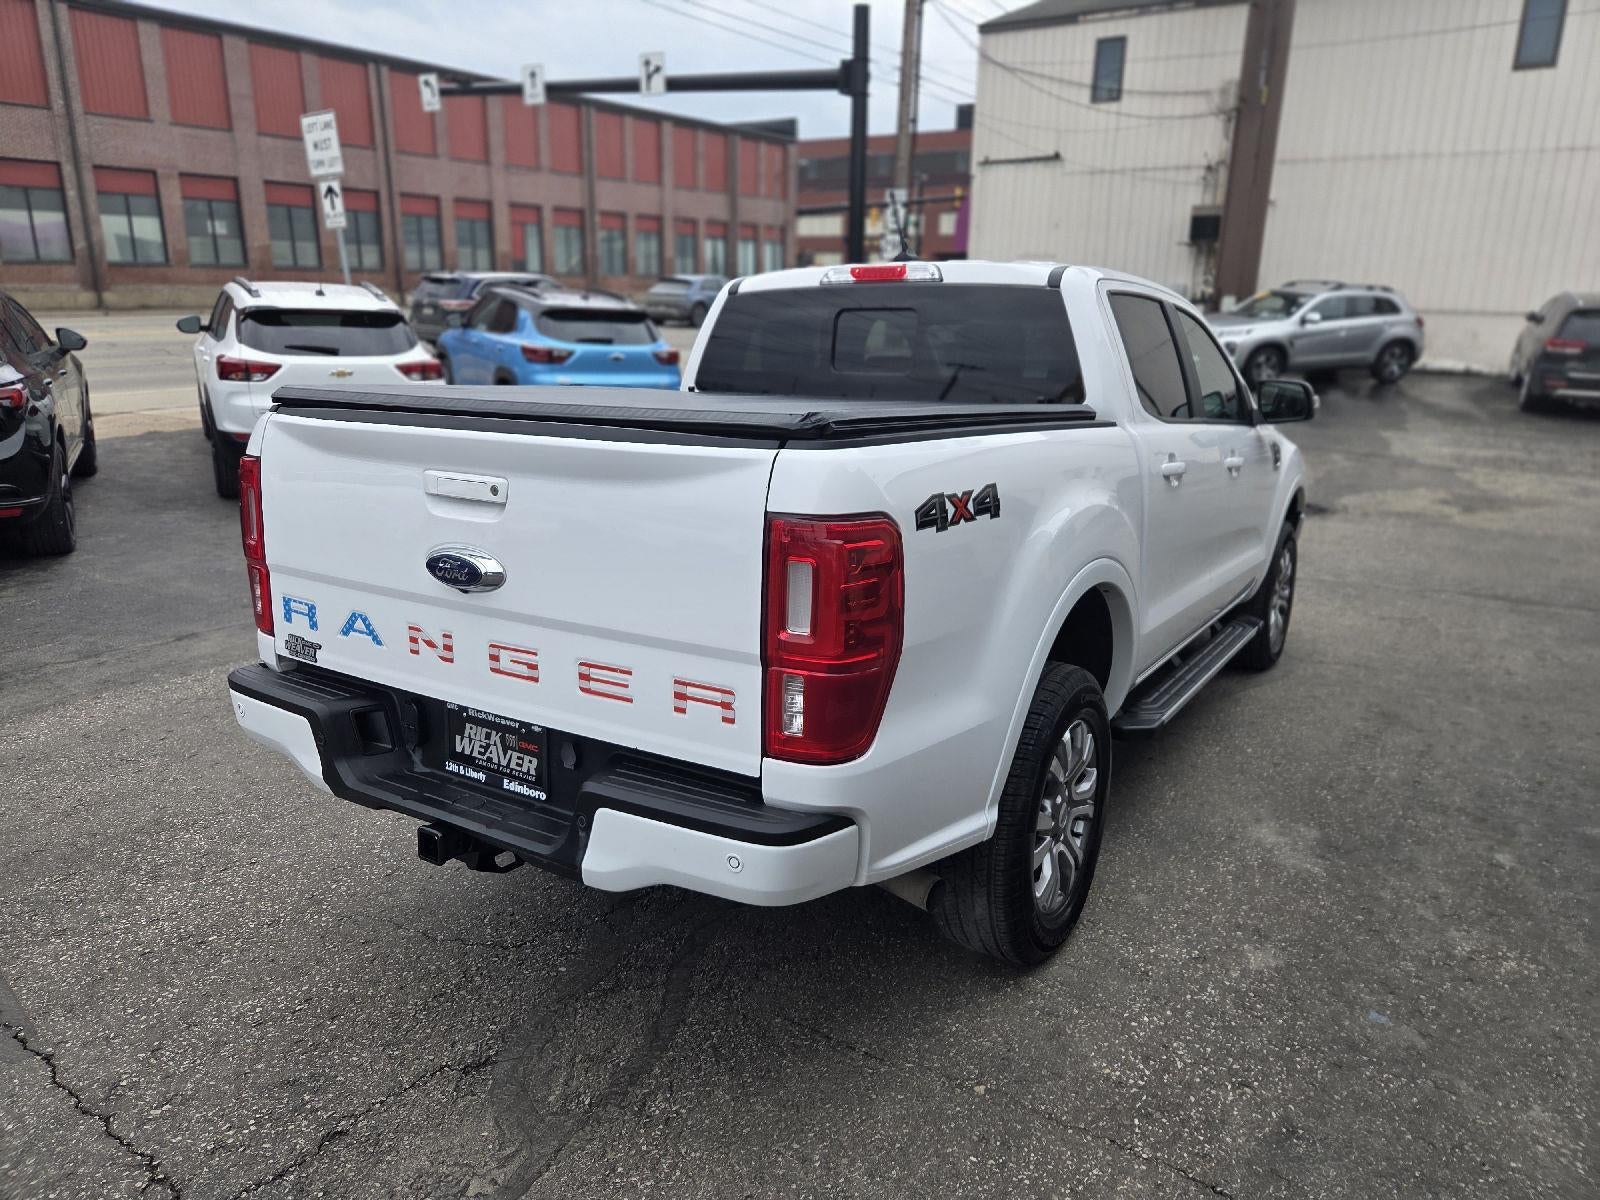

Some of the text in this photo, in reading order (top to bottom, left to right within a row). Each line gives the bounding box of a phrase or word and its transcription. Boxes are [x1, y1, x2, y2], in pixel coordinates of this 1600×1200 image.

[312, 137, 332, 152] MUST
[435, 558, 469, 581] Ford
[282, 593, 737, 726] RANGER
[285, 640, 315, 657] WEAVER
[464, 722, 502, 745] RICK
[455, 734, 538, 776] WEAVER
[518, 740, 540, 752] GMC
[465, 767, 487, 783] Liberty
[475, 758, 498, 770] FAMOUS
[512, 769, 536, 782] SERVICE
[503, 779, 547, 801] Edinboro
